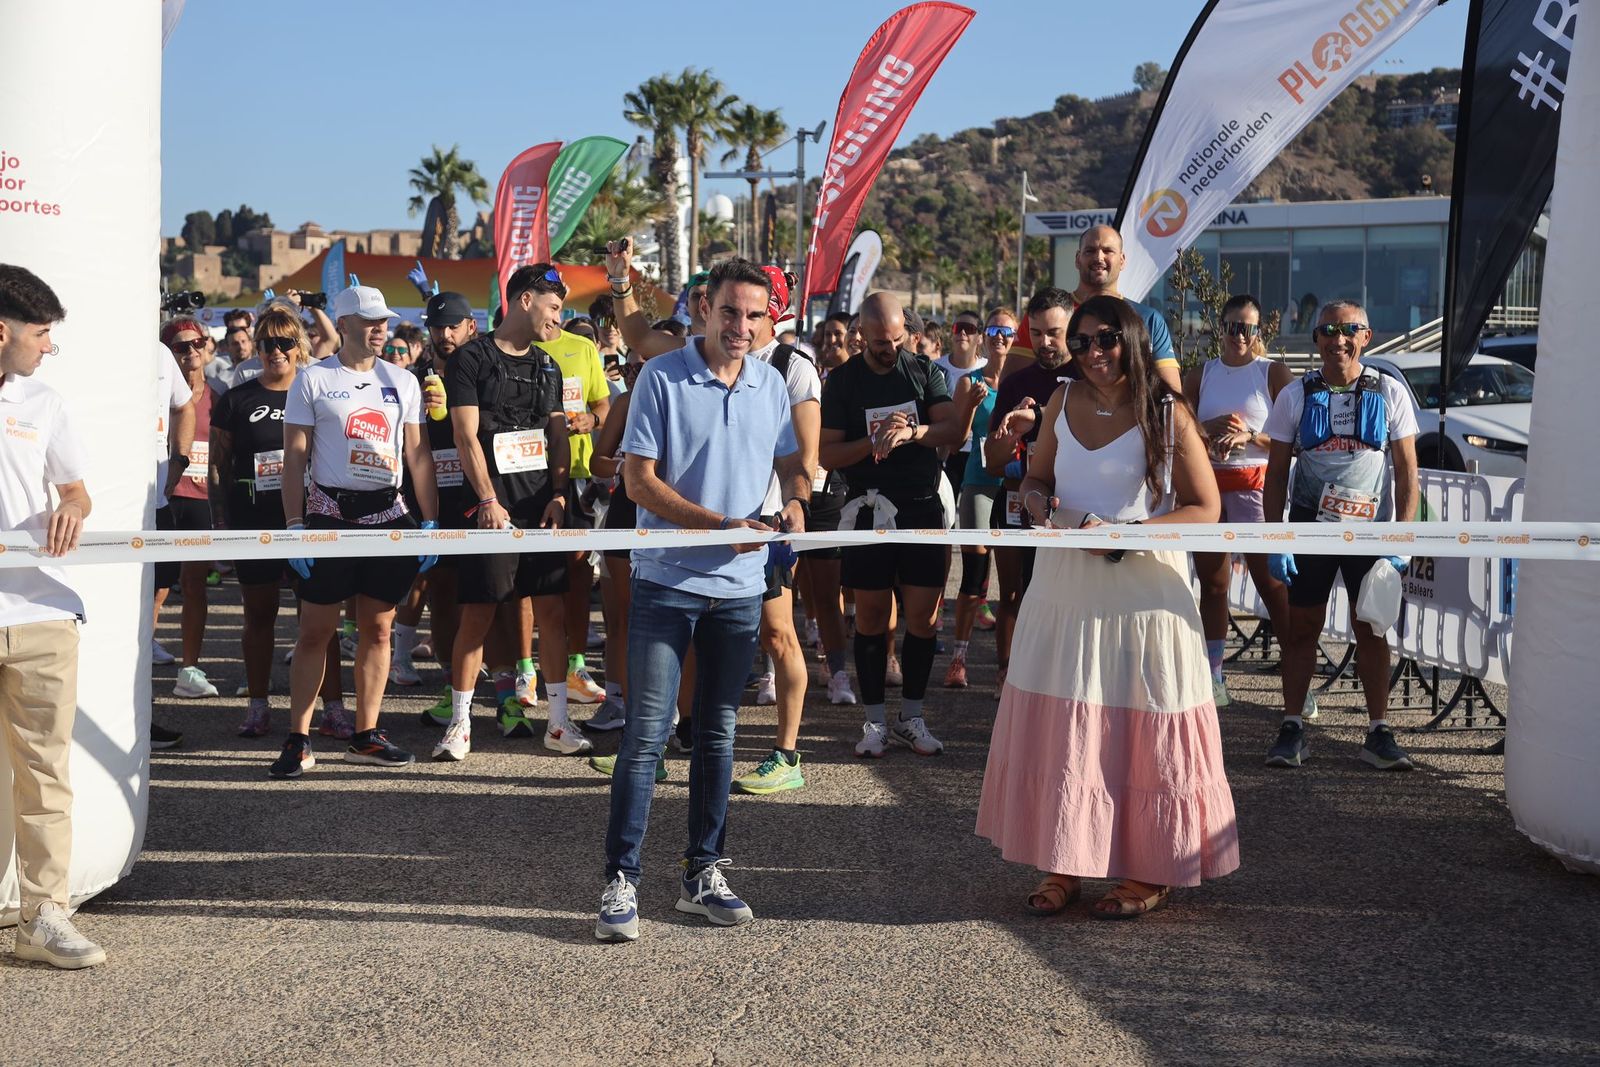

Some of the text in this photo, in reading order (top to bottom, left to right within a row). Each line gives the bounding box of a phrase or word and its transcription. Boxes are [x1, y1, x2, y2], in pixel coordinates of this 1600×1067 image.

[1276, 0, 1409, 105] PLOGGI
[1178, 118, 1240, 186] nationale
[1191, 110, 1272, 197] nederlanden
[1070, 214, 1097, 229] IGY
[351, 427, 385, 442] FRENO
[353, 418, 387, 436] PONLE
[1325, 498, 1371, 517] 24374
[174, 537, 212, 547] PLOGGING
[302, 533, 338, 543] PLOGGING
[1401, 556, 1435, 582] iza
[1409, 583, 1434, 599] Balears
